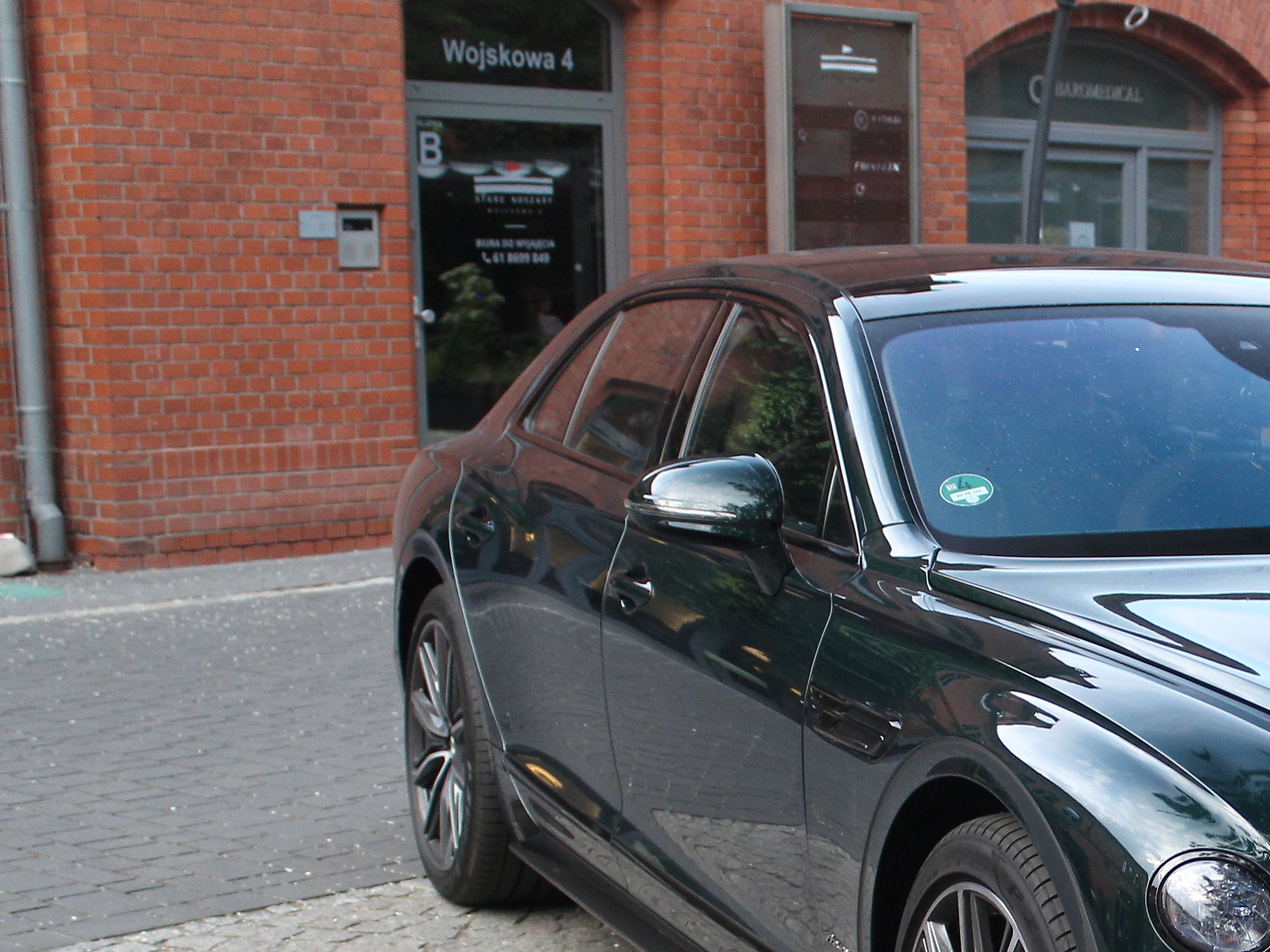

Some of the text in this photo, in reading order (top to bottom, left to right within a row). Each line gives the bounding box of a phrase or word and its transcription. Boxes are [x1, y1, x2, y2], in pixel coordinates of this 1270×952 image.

[442, 38, 575, 71] Wojskowa 4
[419, 131, 443, 164] B
